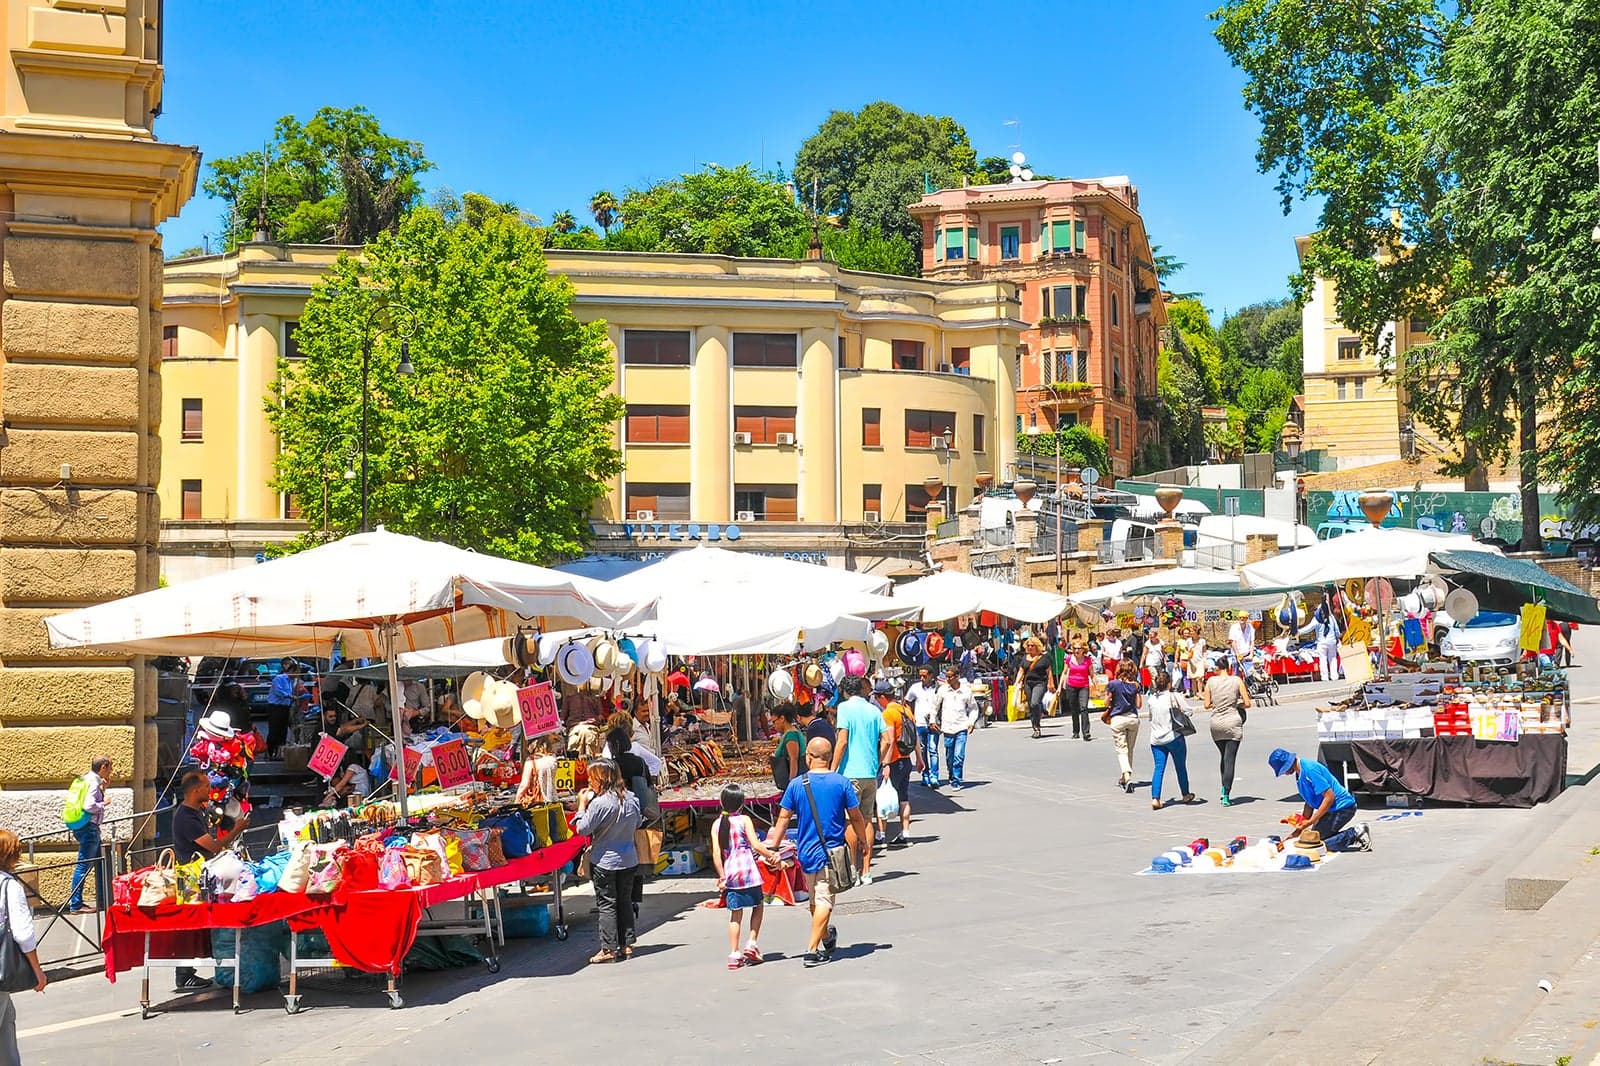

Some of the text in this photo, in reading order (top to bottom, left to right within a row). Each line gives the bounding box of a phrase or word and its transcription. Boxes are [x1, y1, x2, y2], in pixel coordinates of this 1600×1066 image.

[623, 523, 741, 540] VITERBO
[522, 693, 553, 724] 9,99
[556, 761, 570, 769] LO
[556, 778, 574, 789] 00
